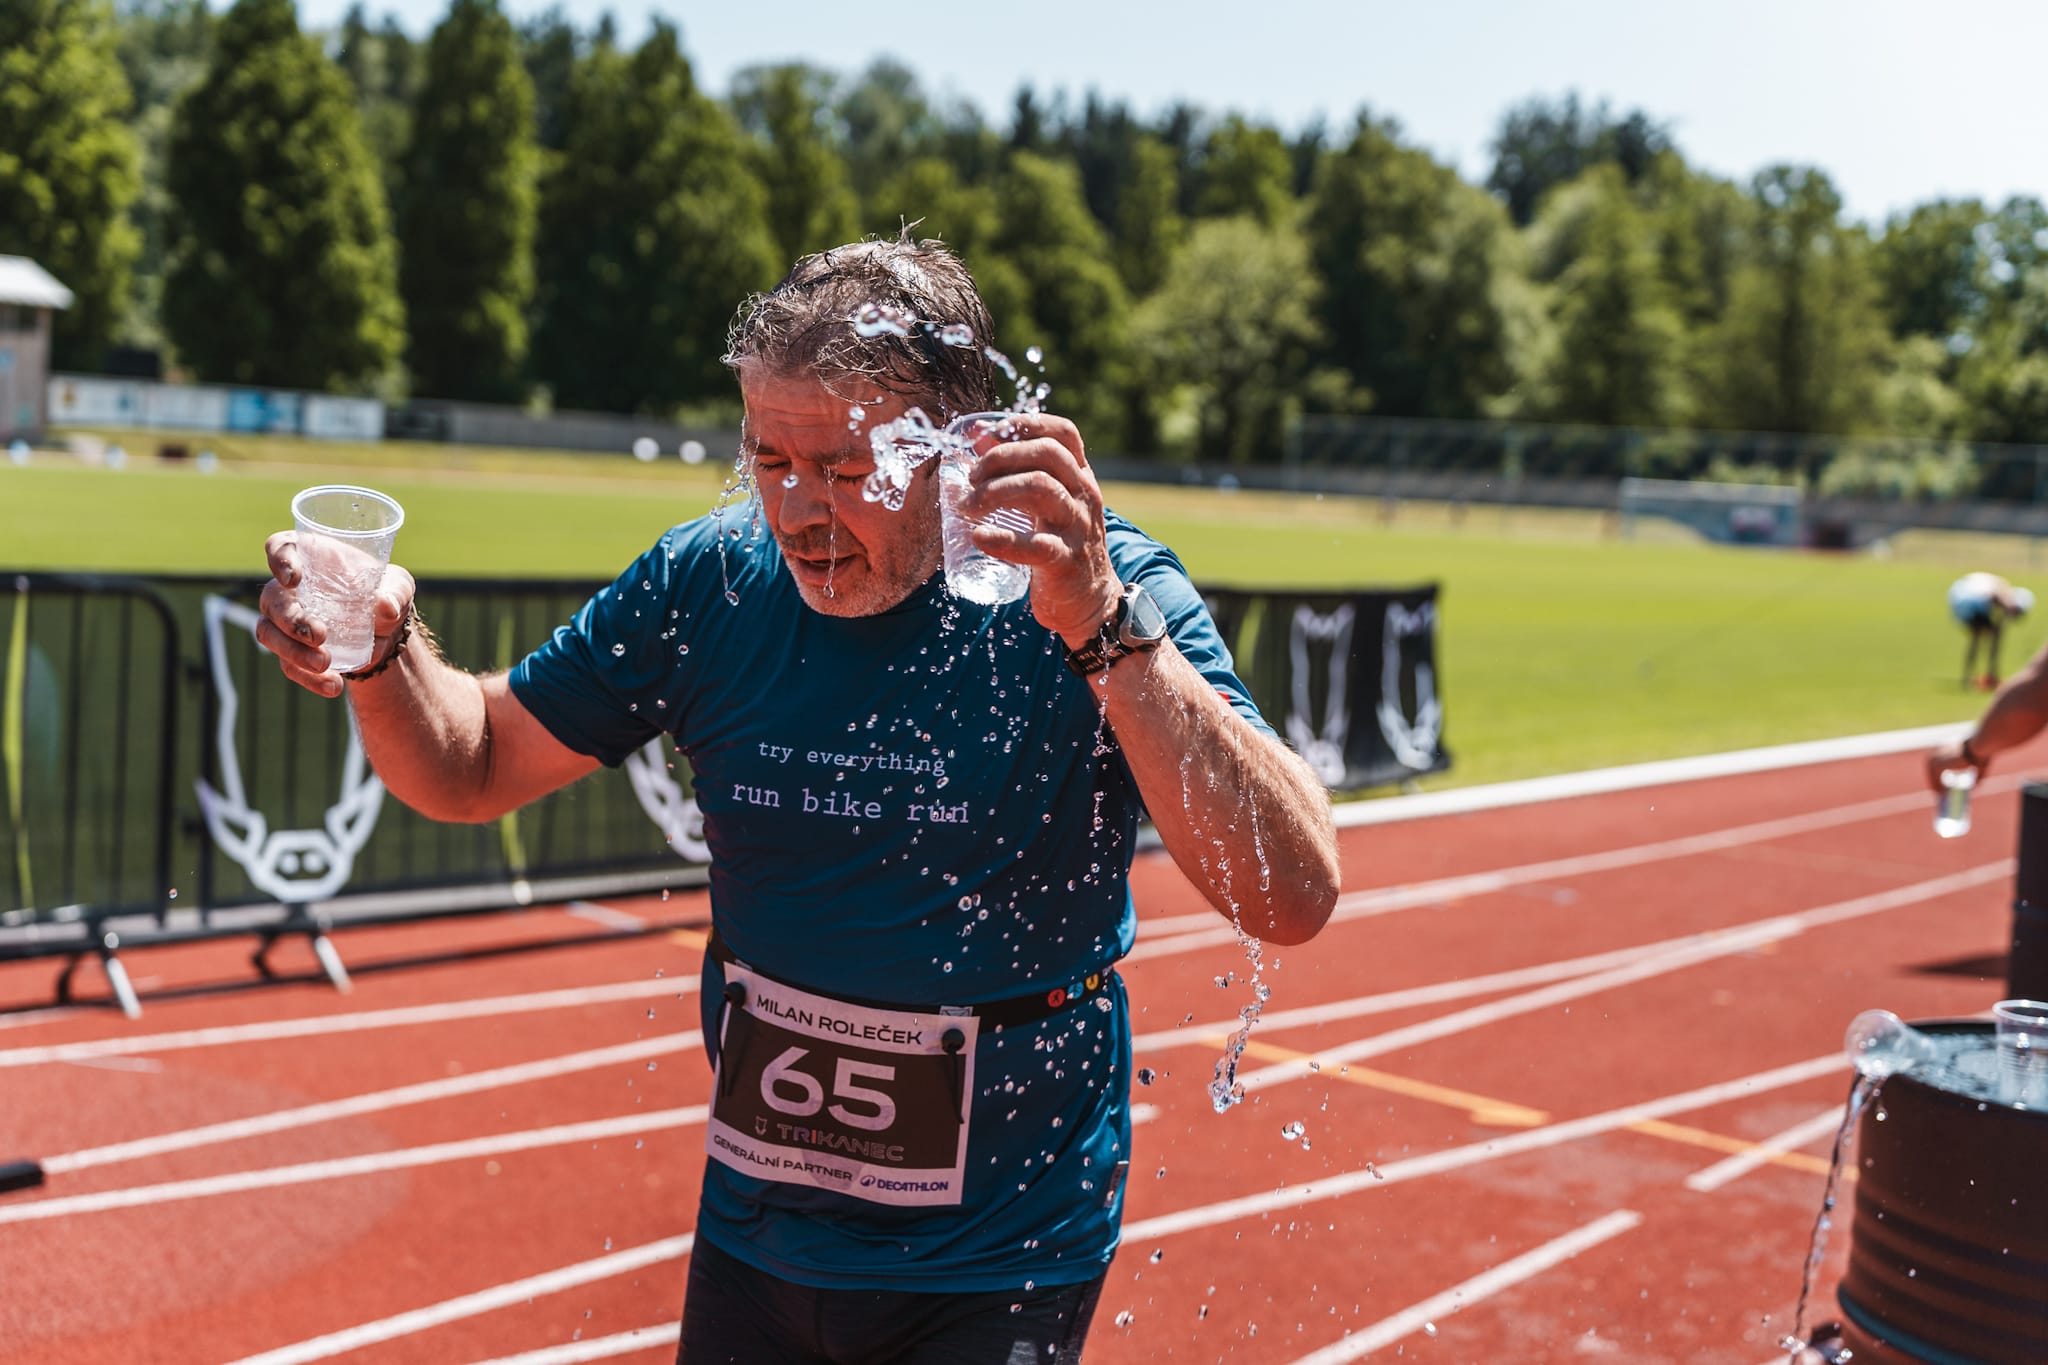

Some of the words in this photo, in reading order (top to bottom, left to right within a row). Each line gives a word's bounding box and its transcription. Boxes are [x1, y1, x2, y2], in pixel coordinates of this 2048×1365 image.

[758, 741, 794, 763] try
[806, 751, 946, 776] everything
[732, 783, 780, 808] run
[802, 788, 882, 819] bike
[906, 803, 969, 824] run
[756, 994, 813, 1028] MILAN
[818, 1015, 923, 1046] ROLEČEK
[760, 1046, 896, 1131] 65
[713, 1134, 780, 1168] GENERÁLNÍ
[783, 1159, 854, 1182] PARTNER
[777, 1122, 905, 1162] TRIKANEC
[877, 1179, 949, 1192] DECATHLON
